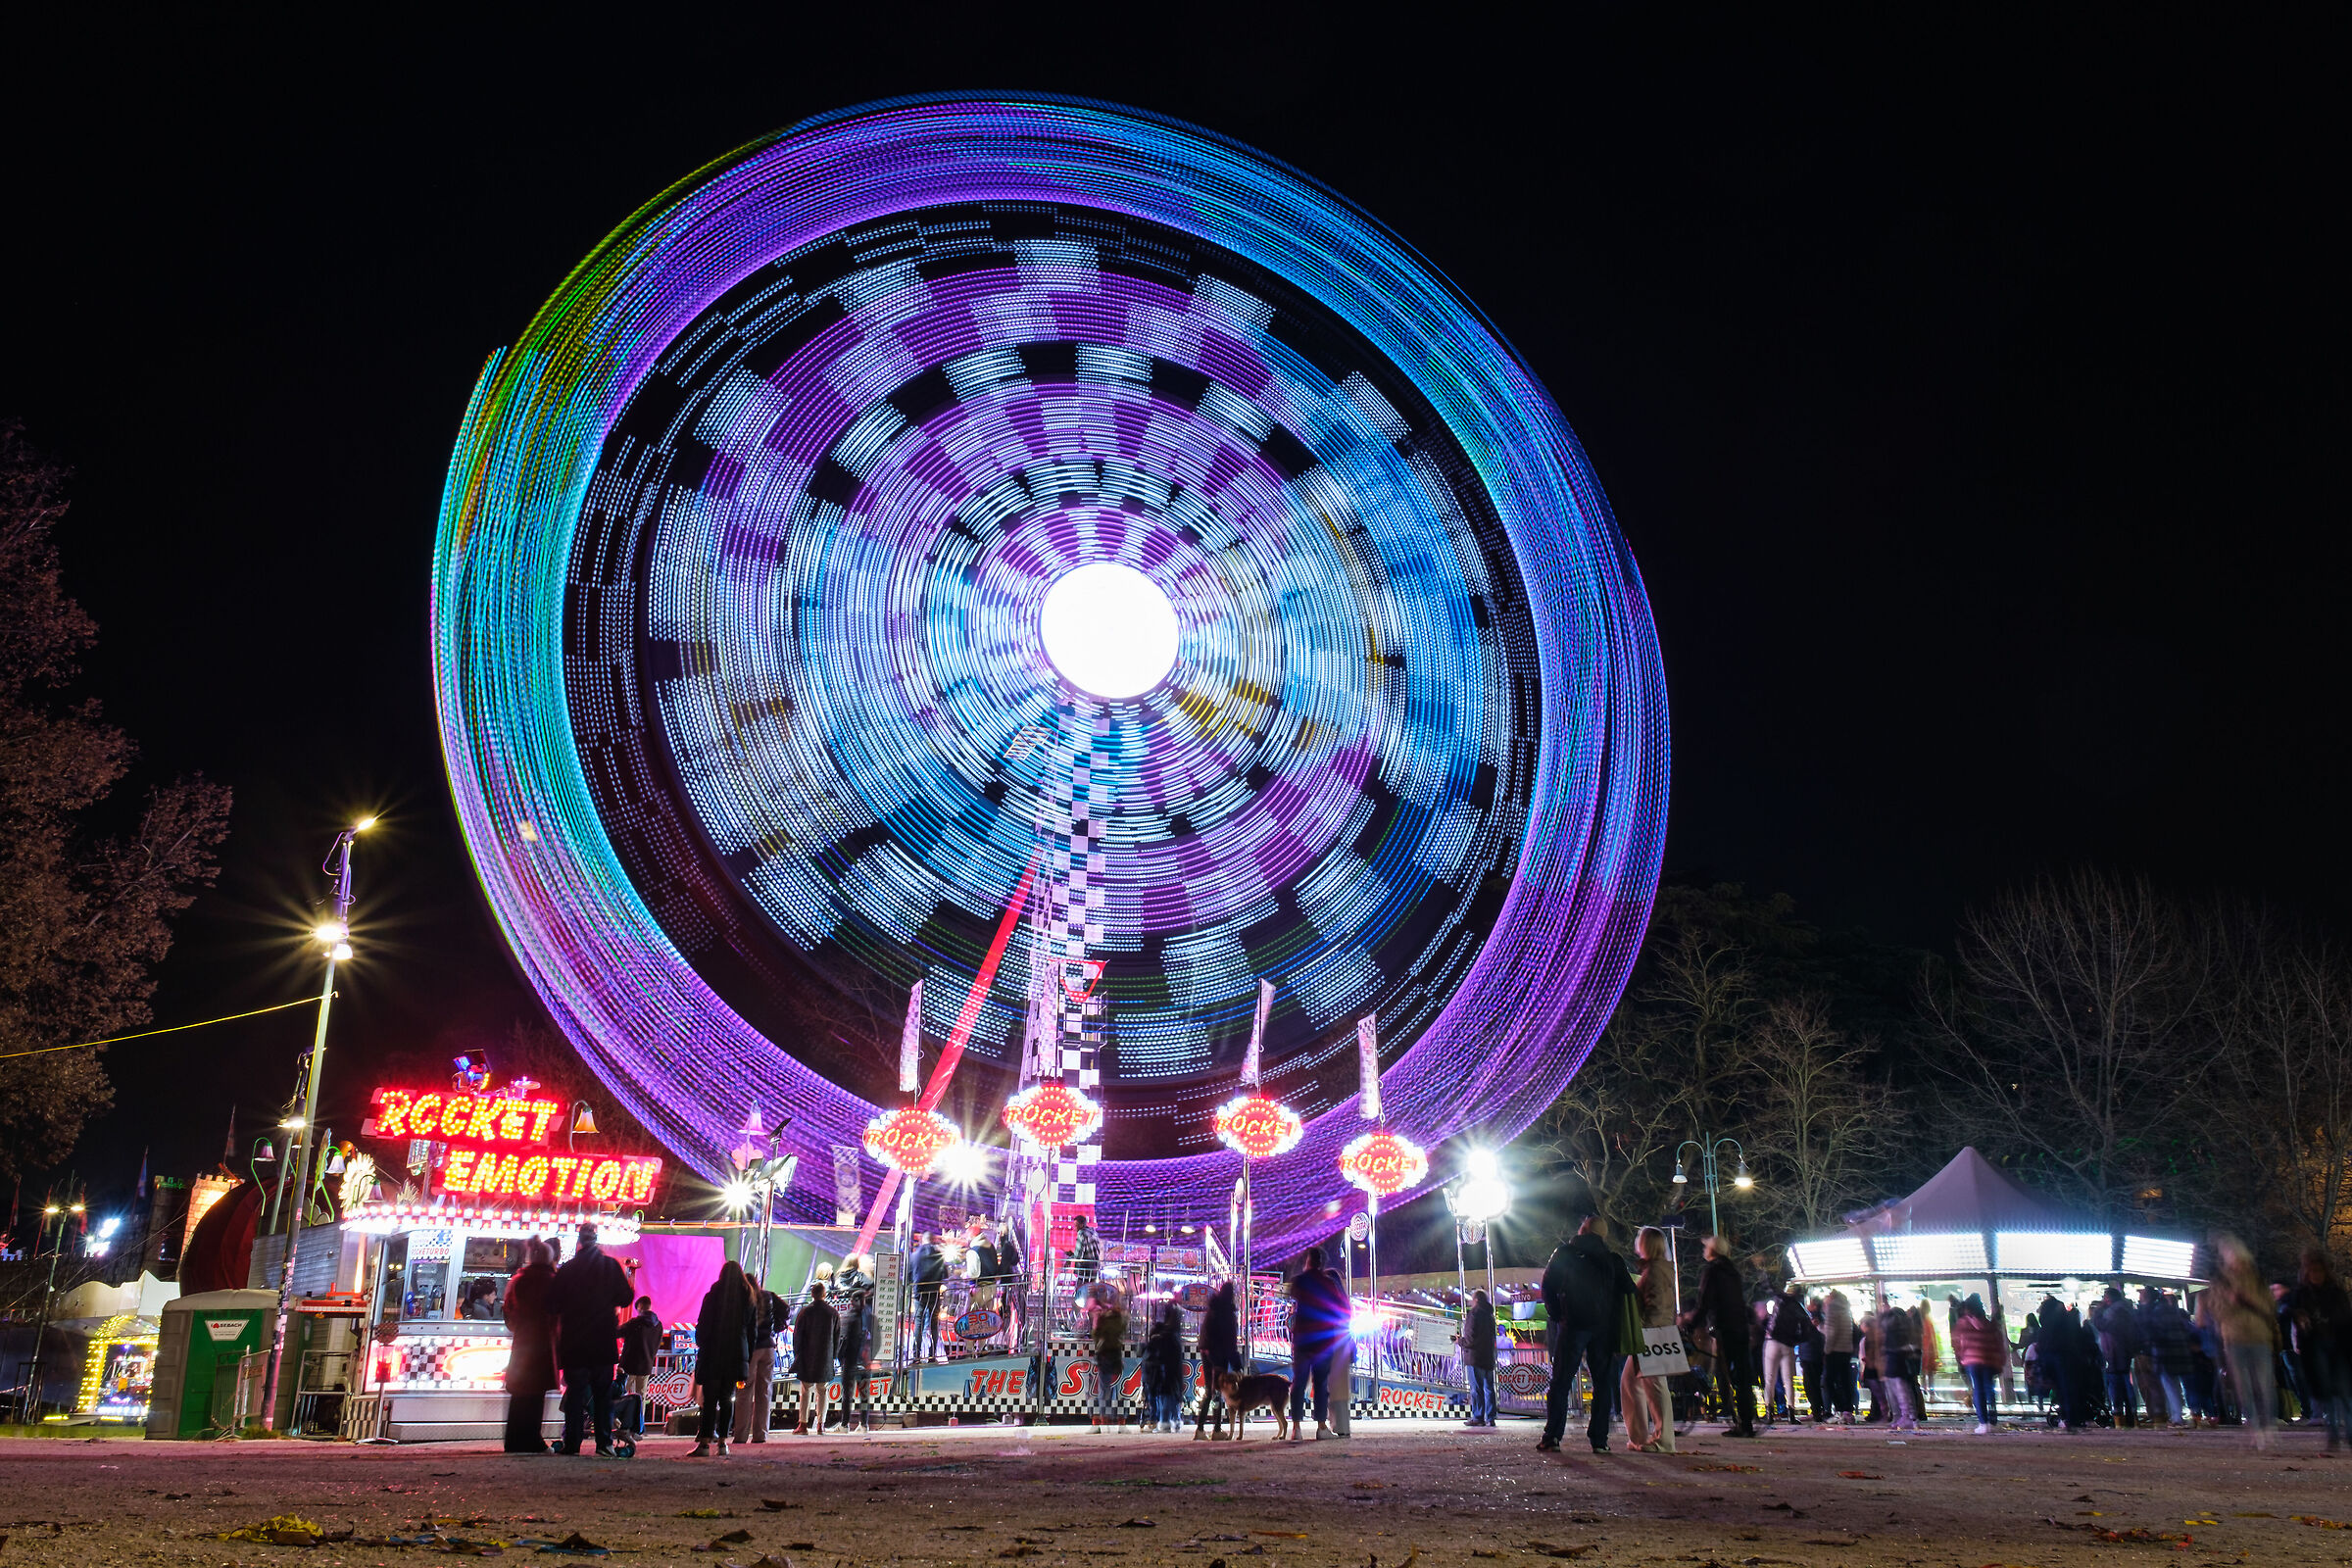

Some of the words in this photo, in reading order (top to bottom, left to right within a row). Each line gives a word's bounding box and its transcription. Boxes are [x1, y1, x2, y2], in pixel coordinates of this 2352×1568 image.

[375, 1089, 559, 1142] ROCKET
[1005, 1103, 1099, 1127] ROCKET
[442, 1150, 657, 1200] EMOTION
[648, 1383, 686, 1395] ROCKET
[971, 1369, 1027, 1396] THE
[1498, 1374, 1526, 1384] ROCKET
[1528, 1374, 1547, 1384] PARK
[1380, 1387, 1446, 1411] ROCKET
